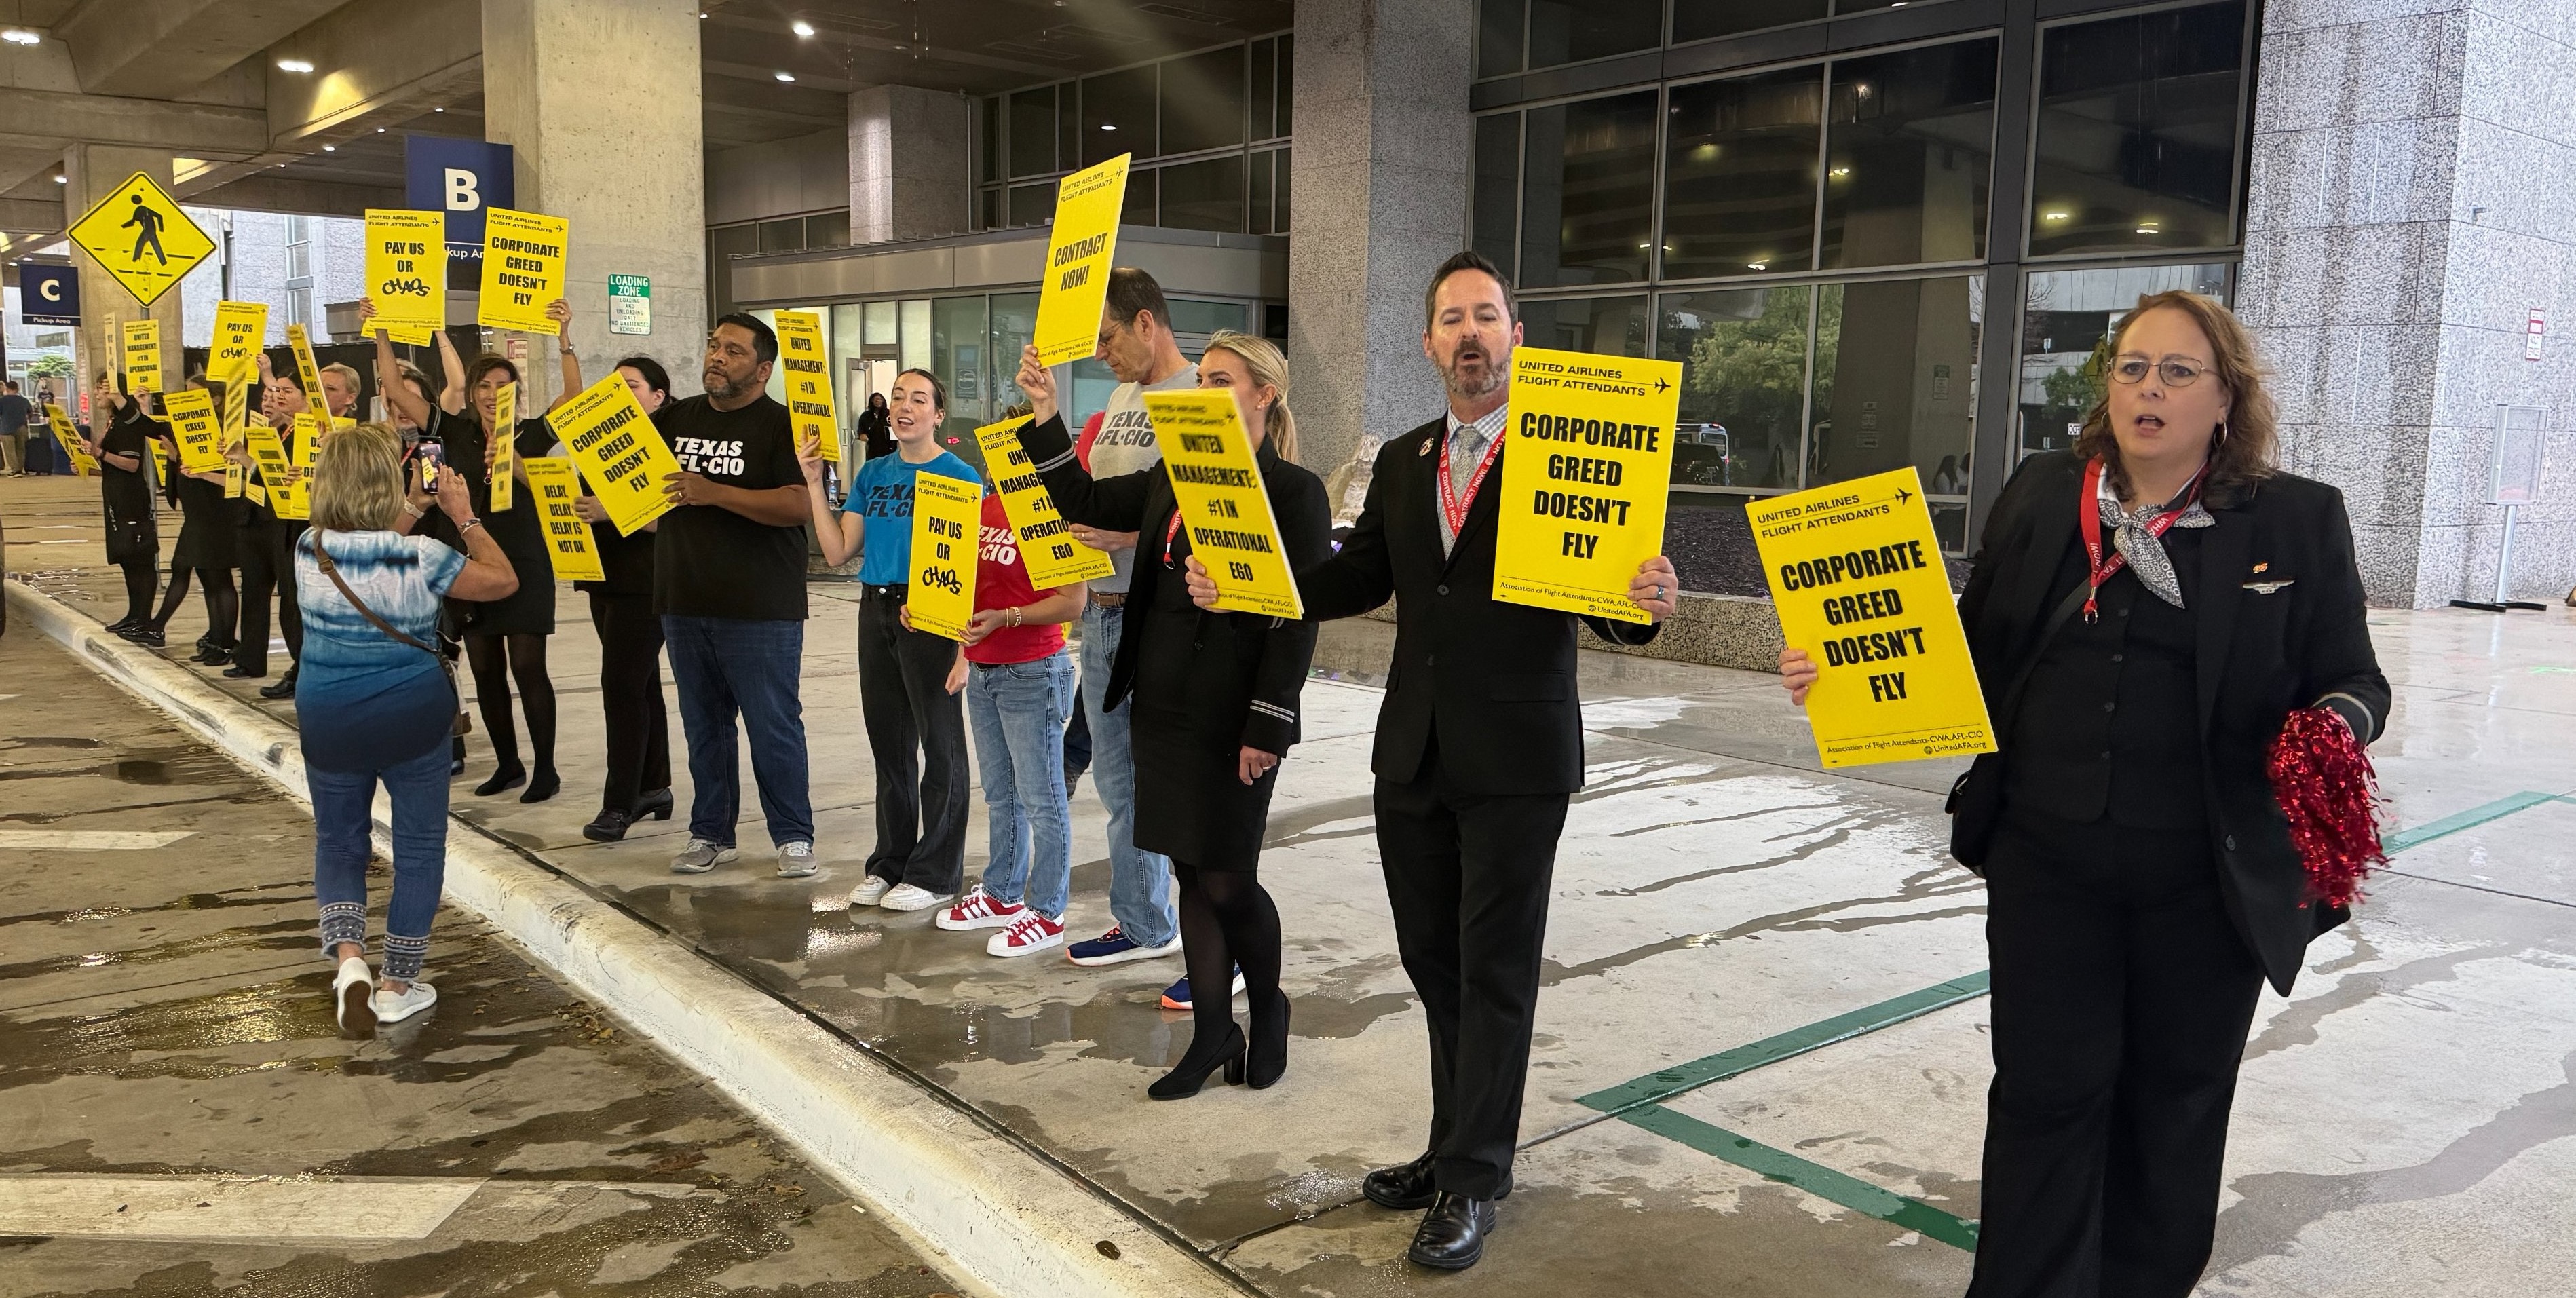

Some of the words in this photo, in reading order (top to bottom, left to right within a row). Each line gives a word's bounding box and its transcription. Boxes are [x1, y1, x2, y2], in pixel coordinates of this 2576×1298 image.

[445, 168, 480, 211] B
[1060, 191, 1078, 203] FLIGHT
[385, 242, 406, 255] PAY
[409, 243, 425, 256] US
[447, 246, 468, 260] kup
[471, 248, 484, 259] Ar
[491, 236, 561, 259] CORPORATE
[1054, 232, 1107, 267] CONTRACT
[397, 259, 413, 273] OR
[506, 256, 543, 273] GREED
[382, 278, 430, 297] CHAOS
[499, 273, 548, 291] DOESN'T
[611, 275, 649, 286] LOADING
[1061, 265, 1090, 292] NOW!
[41, 279, 60, 301] C
[514, 292, 532, 306] FLY
[618, 286, 641, 297] ZONE
[33, 316, 54, 325] Pickup
[227, 322, 242, 332] PAY
[242, 324, 253, 333] US
[233, 335, 244, 344] OR
[790, 337, 812, 351] UNITED
[784, 357, 827, 375] MANAGEMENT:
[1519, 360, 1564, 373] UNITED
[1566, 365, 1623, 379] AIRLINES
[801, 381, 810, 394] #1
[809, 381, 816, 394] IN
[1517, 375, 1559, 388] FLIGHT
[1562, 379, 1645, 396] ATTENDANTS
[172, 408, 212, 421] CORPORATE
[792, 400, 831, 418] OPERATIONAL
[185, 421, 206, 432] GREED
[571, 404, 639, 453] CORPORATE
[808, 423, 820, 436] EGO
[981, 432, 1004, 442] UNITED
[1005, 427, 1018, 436] AIRL
[1520, 412, 1660, 453] CORPORATE
[197, 445, 208, 455] FLY
[597, 432, 636, 462] GREED
[675, 436, 744, 457] TEXAS
[985, 440, 1005, 451] FLIGHT
[1180, 433, 1225, 455] UNITED
[603, 446, 651, 484] DOESN'T
[1007, 449, 1028, 466] UNI
[1547, 453, 1623, 487] GREED
[544, 484, 569, 499] DELAY,
[629, 472, 651, 493] FLY
[918, 478, 936, 489] UNITED
[937, 484, 959, 494] AIRLINES
[1000, 472, 1044, 495] MANAGE
[1442, 471, 1454, 508] CONTRACT
[869, 484, 915, 501] TEXA
[918, 488, 935, 497] FLIGHT
[935, 491, 968, 504] ATTENDANTS
[549, 503, 575, 517] DELAY,
[1032, 497, 1047, 514] #1
[1207, 499, 1222, 517] #1
[1224, 500, 1239, 519] IN
[1458, 488, 1476, 527] CONTRACT
[1533, 489, 1631, 526] DOESN'T
[1757, 508, 1802, 524] UNITED
[1805, 494, 1860, 514] AIRLINES
[550, 521, 573, 535] DELAY
[573, 522, 582, 535] IS
[928, 516, 947, 536] PAY
[949, 521, 962, 540] US
[1020, 518, 1069, 541] OPERATIO
[1761, 522, 1802, 539] FLIGHT
[1806, 504, 1890, 531] ATTENDANTS
[2147, 517, 2170, 538] WHA
[979, 525, 1016, 545] EXAS
[1194, 527, 1273, 554] OPERATIONAL
[557, 540, 574, 553] NOT
[936, 542, 951, 561] OR
[1051, 543, 1074, 560] EGO
[1562, 531, 1599, 560] FLY
[1228, 560, 1254, 582] EGO
[1780, 539, 1927, 592] CORPORATE
[922, 565, 962, 596] CHAOS
[1500, 581, 1535, 592] Association
[1544, 588, 1561, 598] Flight
[1823, 588, 1903, 626] GREED
[1823, 627, 1926, 668] DOESN'T
[1868, 672, 1908, 703] FLY
[1827, 745, 1863, 754] Association
[1873, 740, 1891, 750] Flight
[1933, 742, 1987, 752] UnitedAFA.org
